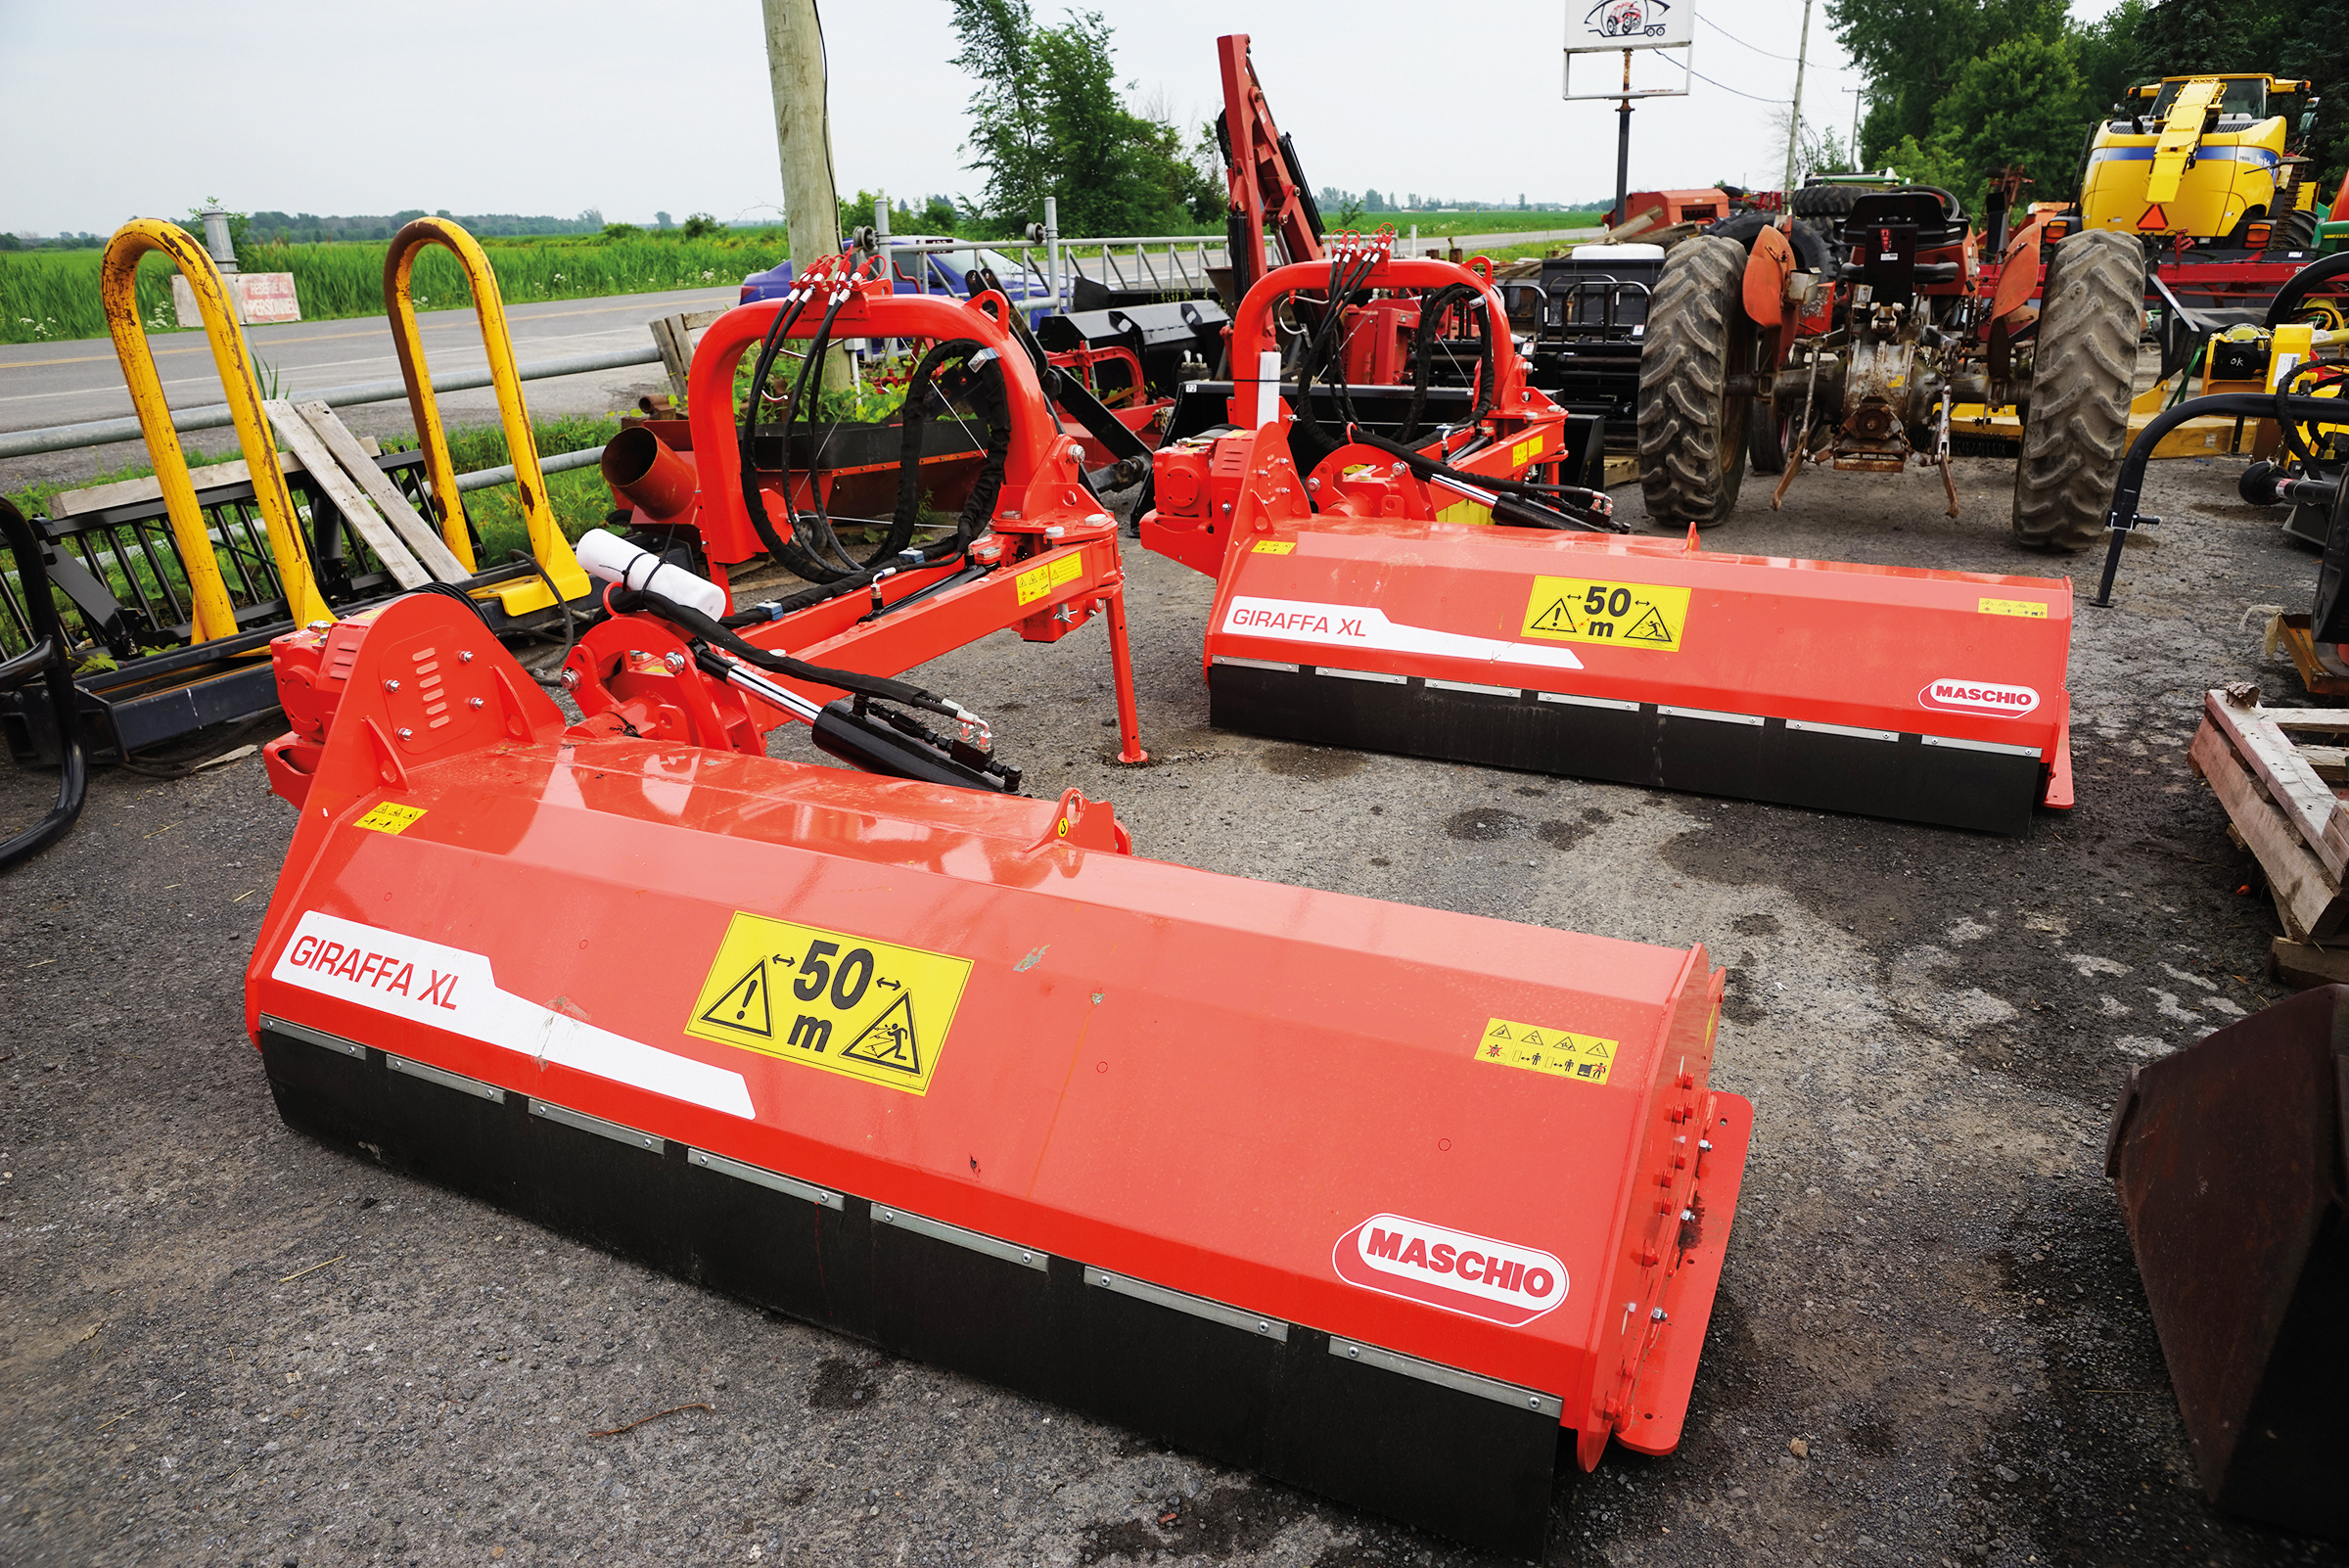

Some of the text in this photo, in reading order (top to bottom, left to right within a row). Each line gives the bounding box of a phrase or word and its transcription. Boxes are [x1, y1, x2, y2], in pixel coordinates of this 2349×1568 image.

[248, 298, 299, 315] PERSONNEL
[1583, 585, 1632, 618] 50
[1232, 609, 1366, 637] GIRAFFA XL
[1588, 621, 1614, 637] m
[1935, 685, 2032, 706] MASCHIO
[289, 935, 459, 1011] GIRAFFA XL
[793, 939, 875, 1010] 50
[787, 1014, 833, 1053] m
[1366, 1226, 1554, 1298] MASCHIO
